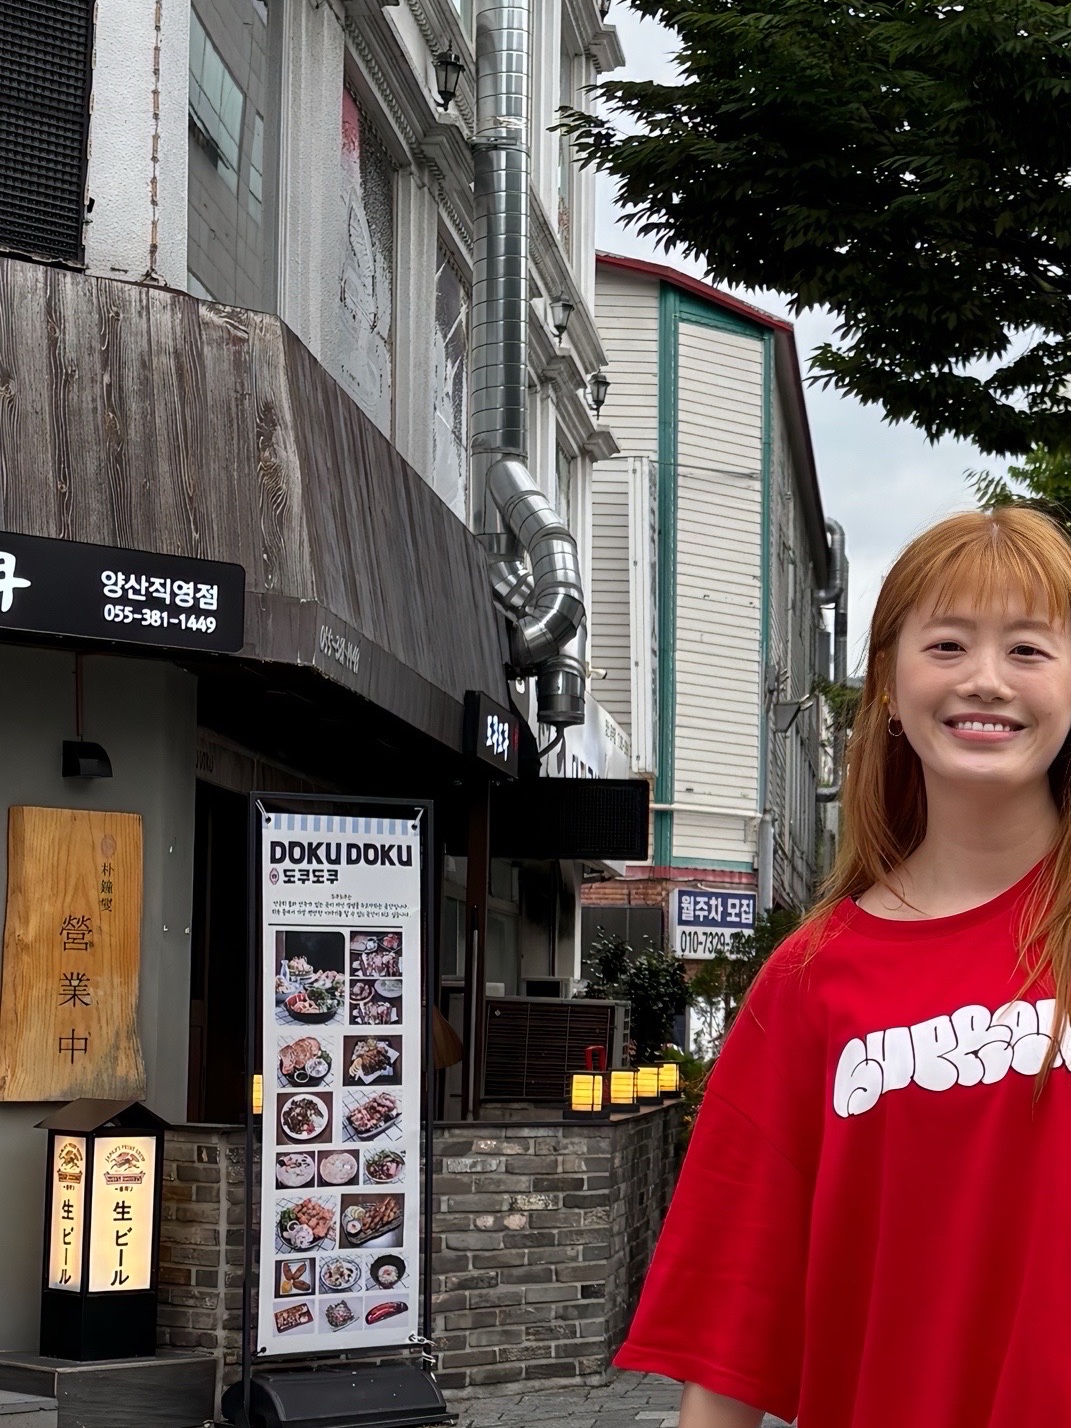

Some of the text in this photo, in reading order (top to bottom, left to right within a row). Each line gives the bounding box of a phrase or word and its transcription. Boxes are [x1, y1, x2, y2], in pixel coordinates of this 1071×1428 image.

[101, 570, 218, 611] 양산직영점
[104, 603, 216, 634] 055-381-1449
[270, 841, 413, 867] DOKU DOKU
[283, 868, 339, 884] 도쿠도쿠
[681, 895, 753, 924] 월주차 모집
[58, 914, 93, 1065] 營業中
[58, 1198, 75, 1286] 生ビール
[110, 1200, 133, 1286] 生ビール
